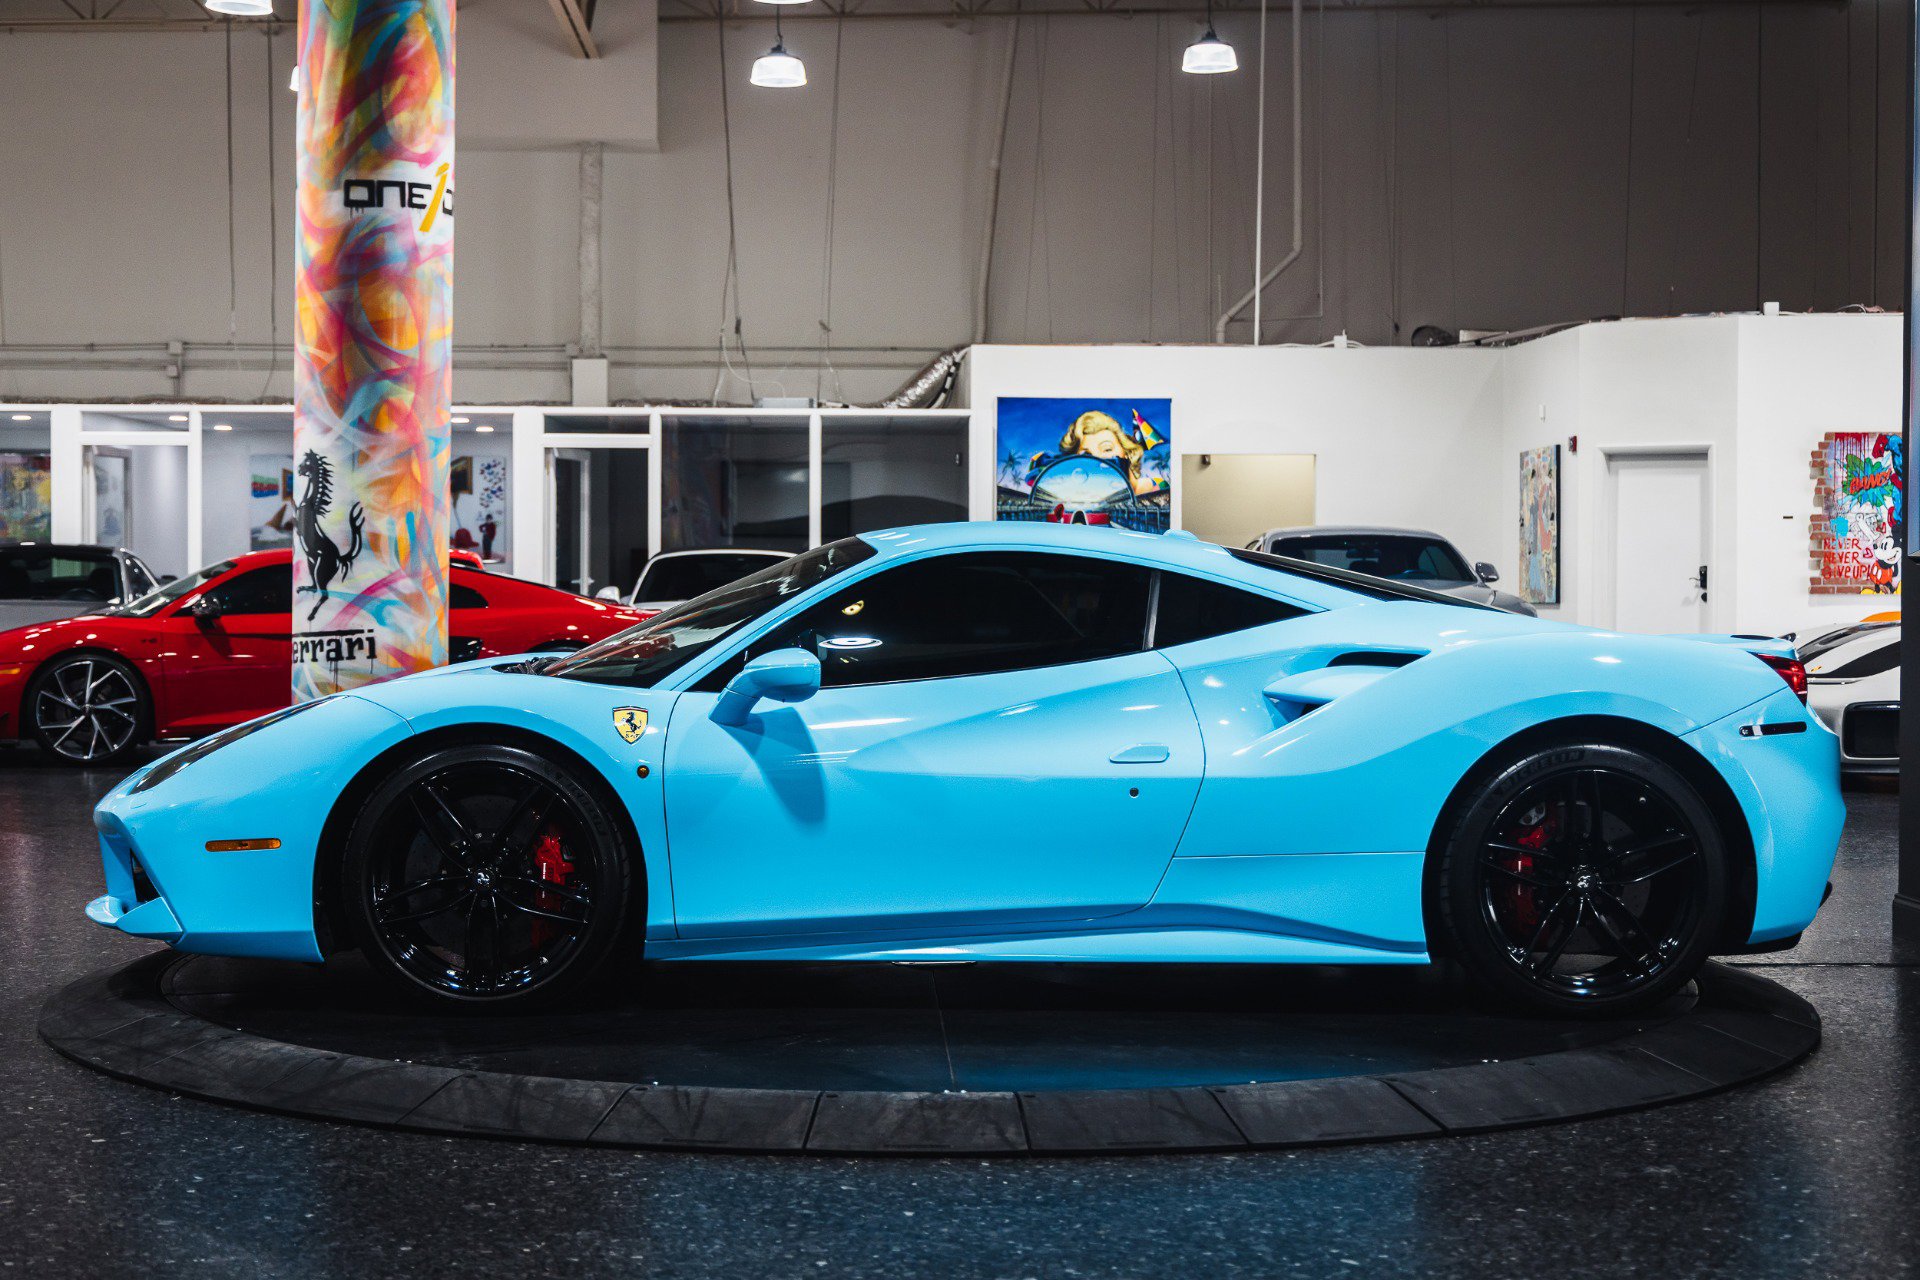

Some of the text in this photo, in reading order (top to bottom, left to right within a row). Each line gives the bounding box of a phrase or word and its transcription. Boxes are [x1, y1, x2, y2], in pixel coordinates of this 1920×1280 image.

[1824, 537, 1861, 550] NEVER
[1824, 552, 1860, 564] NEVER
[292, 629, 377, 663] errari
